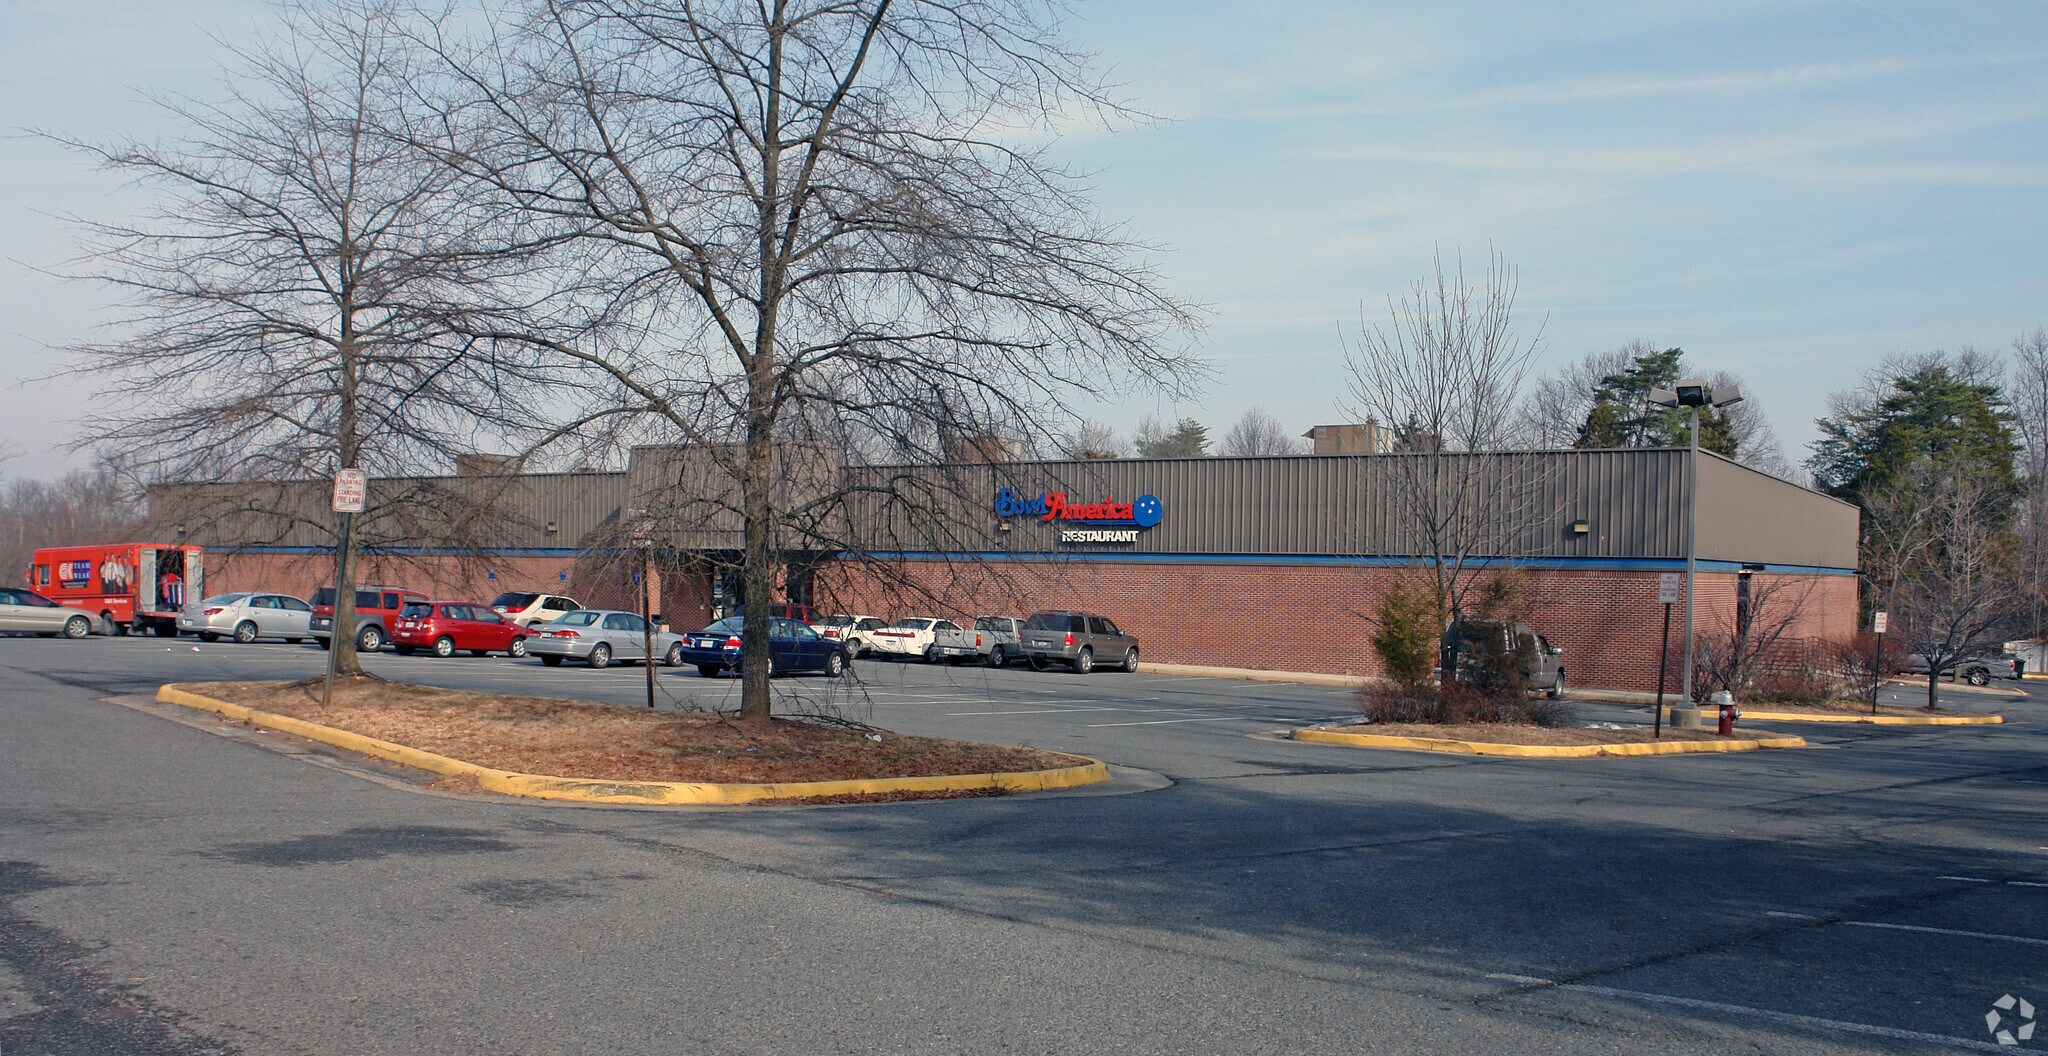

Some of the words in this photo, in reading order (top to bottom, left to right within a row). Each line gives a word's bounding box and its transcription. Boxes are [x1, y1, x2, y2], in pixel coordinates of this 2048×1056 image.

[995, 487, 1048, 516] Bowl
[1041, 491, 1134, 521] America
[1062, 530, 1139, 542] RESTAURANT
